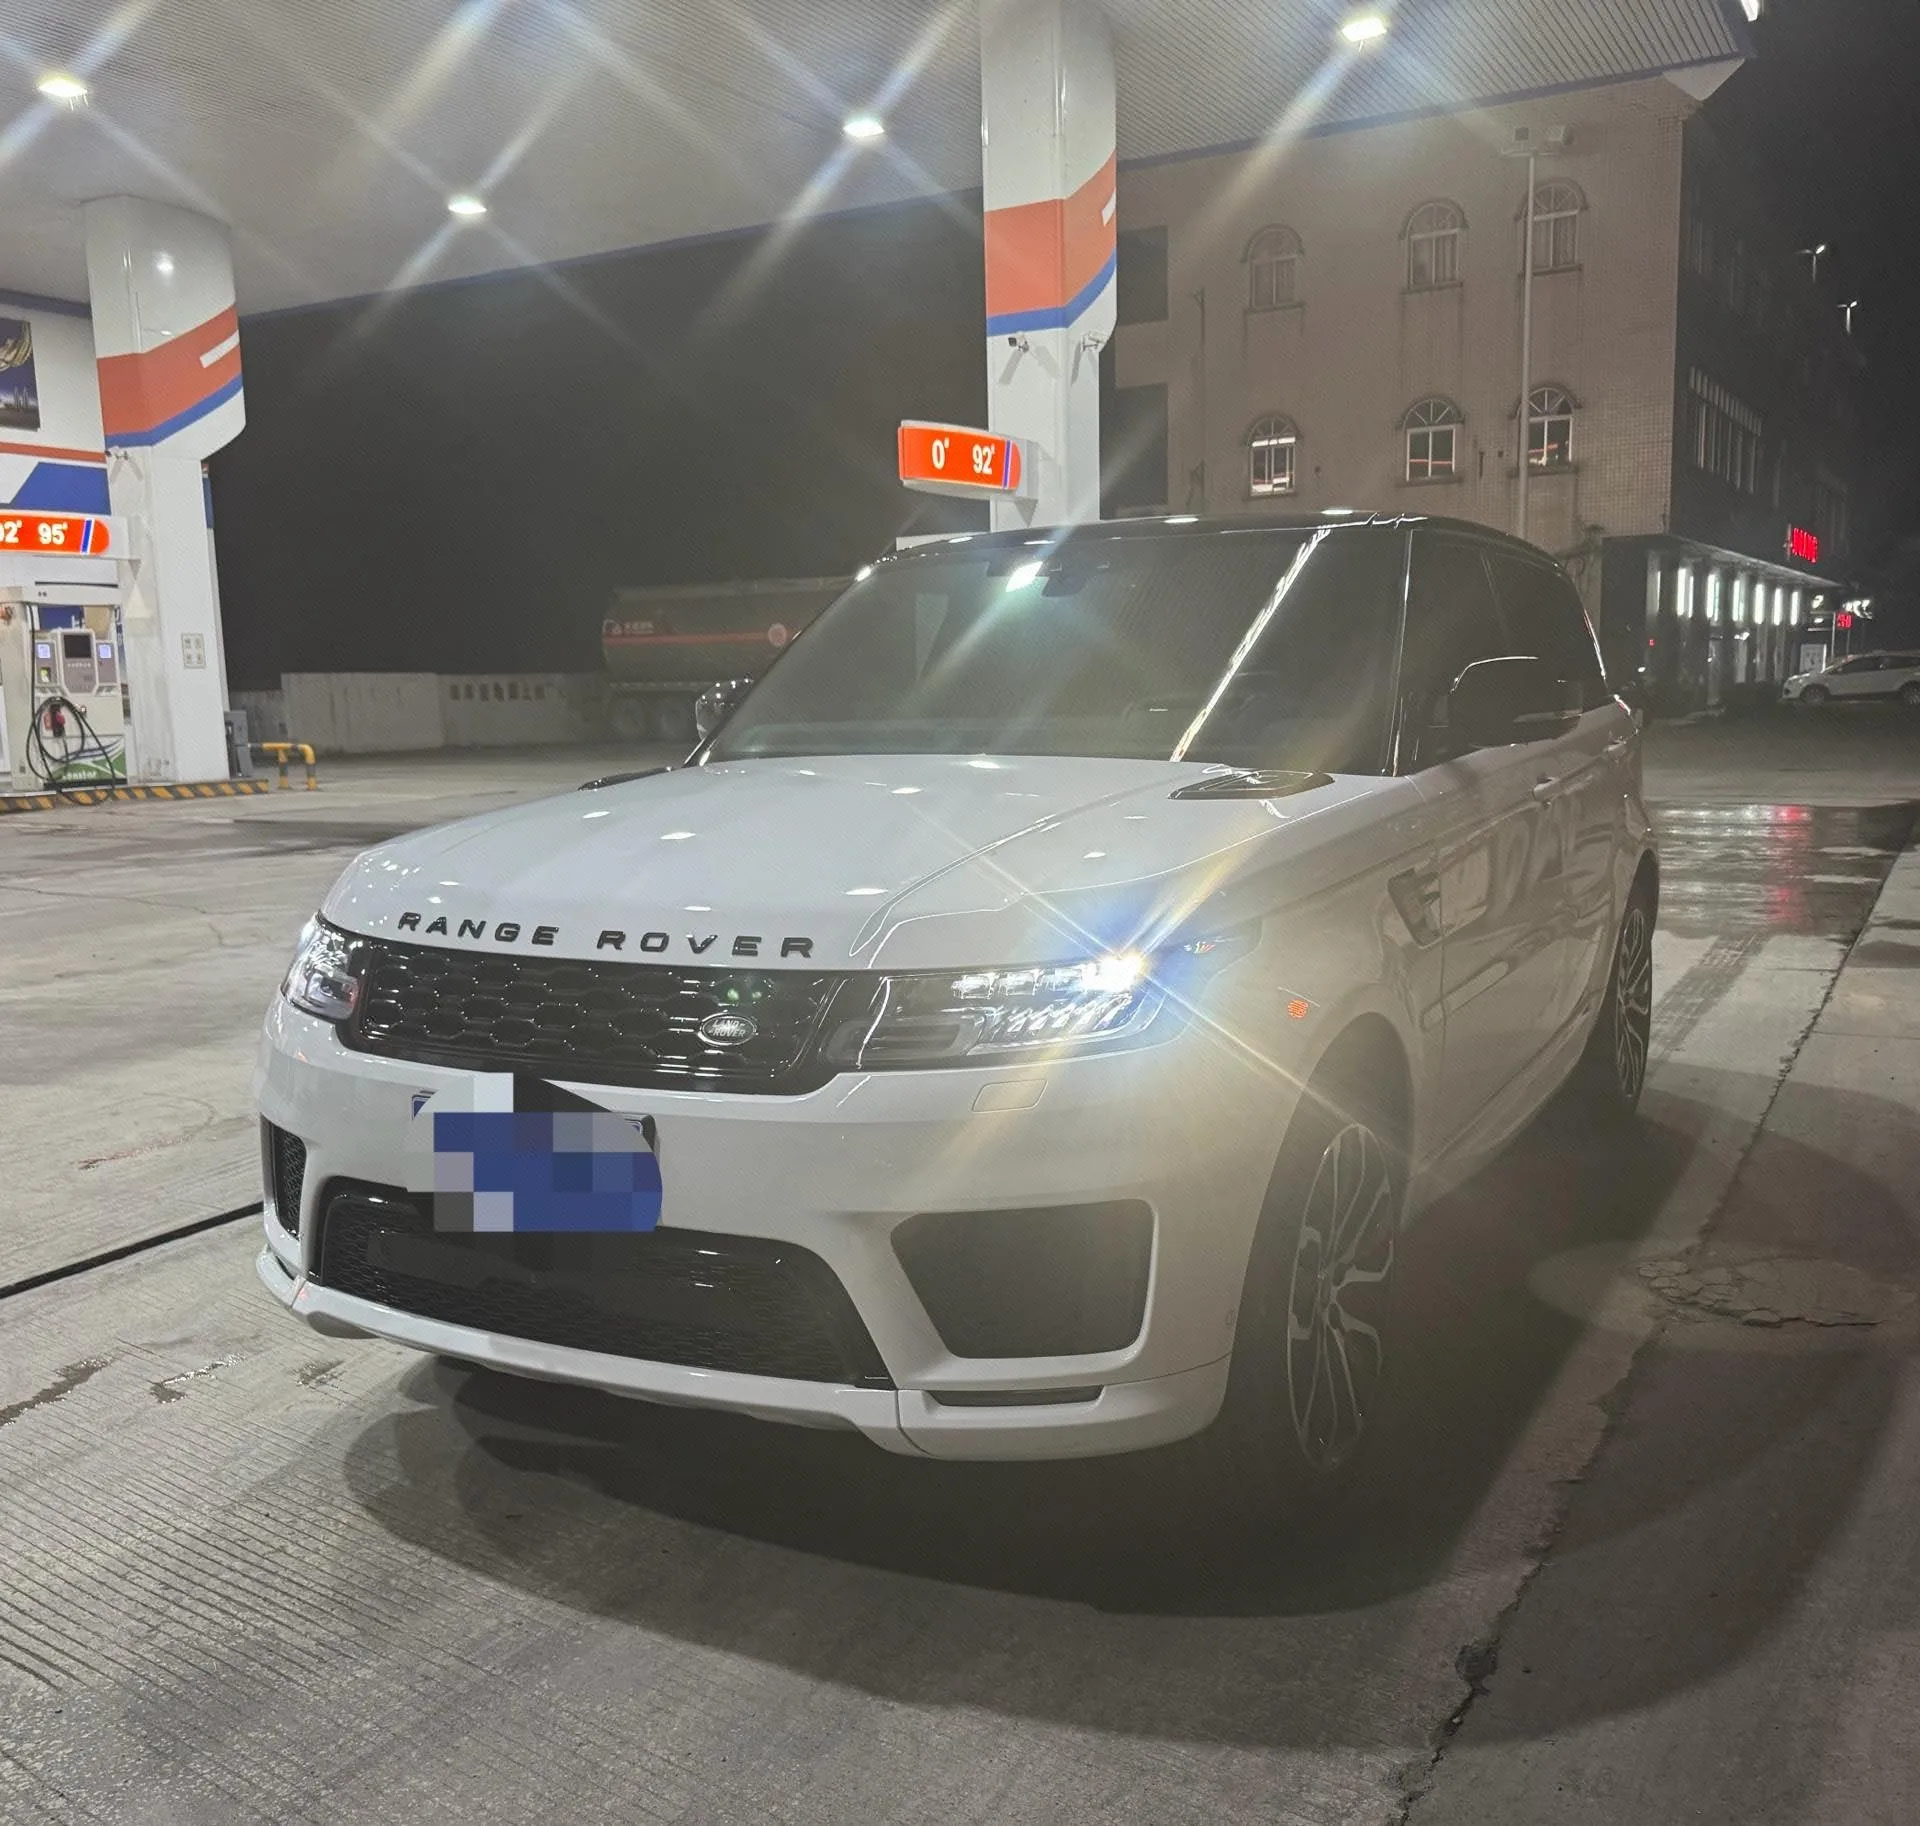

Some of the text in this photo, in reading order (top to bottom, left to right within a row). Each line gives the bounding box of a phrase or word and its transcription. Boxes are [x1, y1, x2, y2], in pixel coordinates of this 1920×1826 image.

[398, 911, 814, 959] RANGE ROVER
[712, 1027, 747, 1037] ROVER
